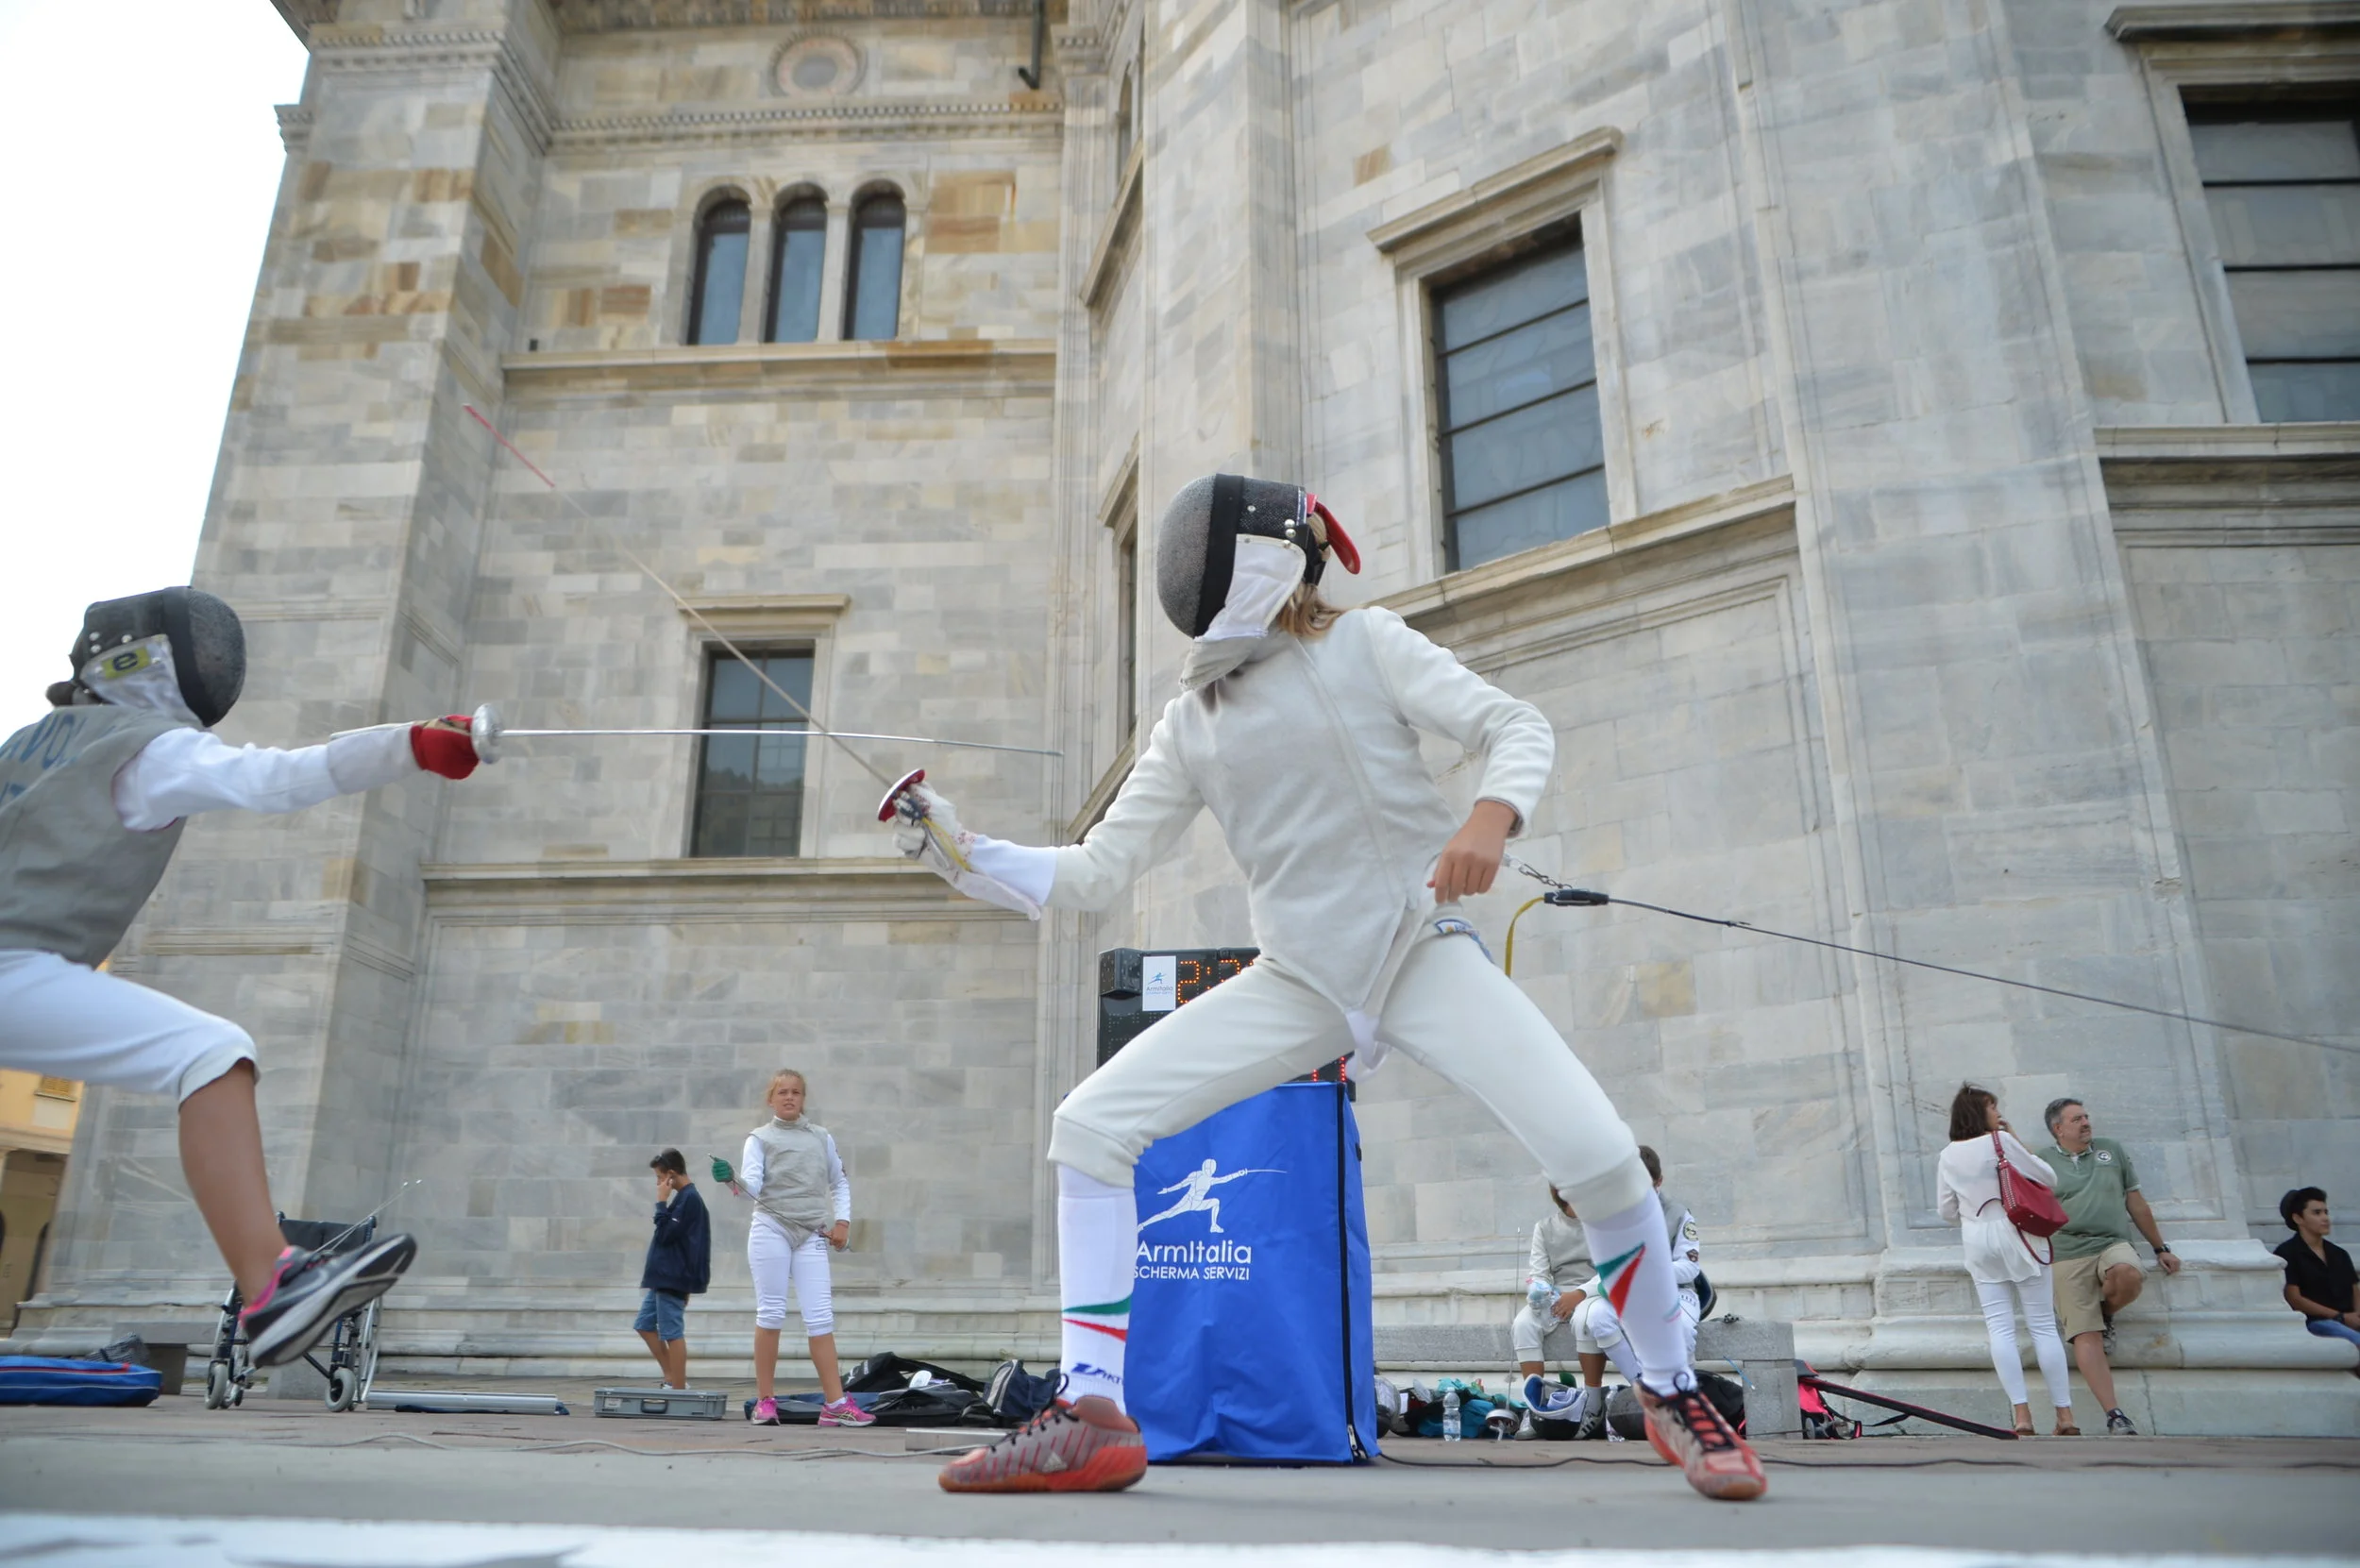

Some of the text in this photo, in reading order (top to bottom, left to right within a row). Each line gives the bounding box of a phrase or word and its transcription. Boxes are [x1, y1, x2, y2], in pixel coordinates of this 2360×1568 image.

[1135, 1239, 1252, 1264] ArmItalia
[1133, 1265, 1250, 1280] SCHERMA SERVIZI
